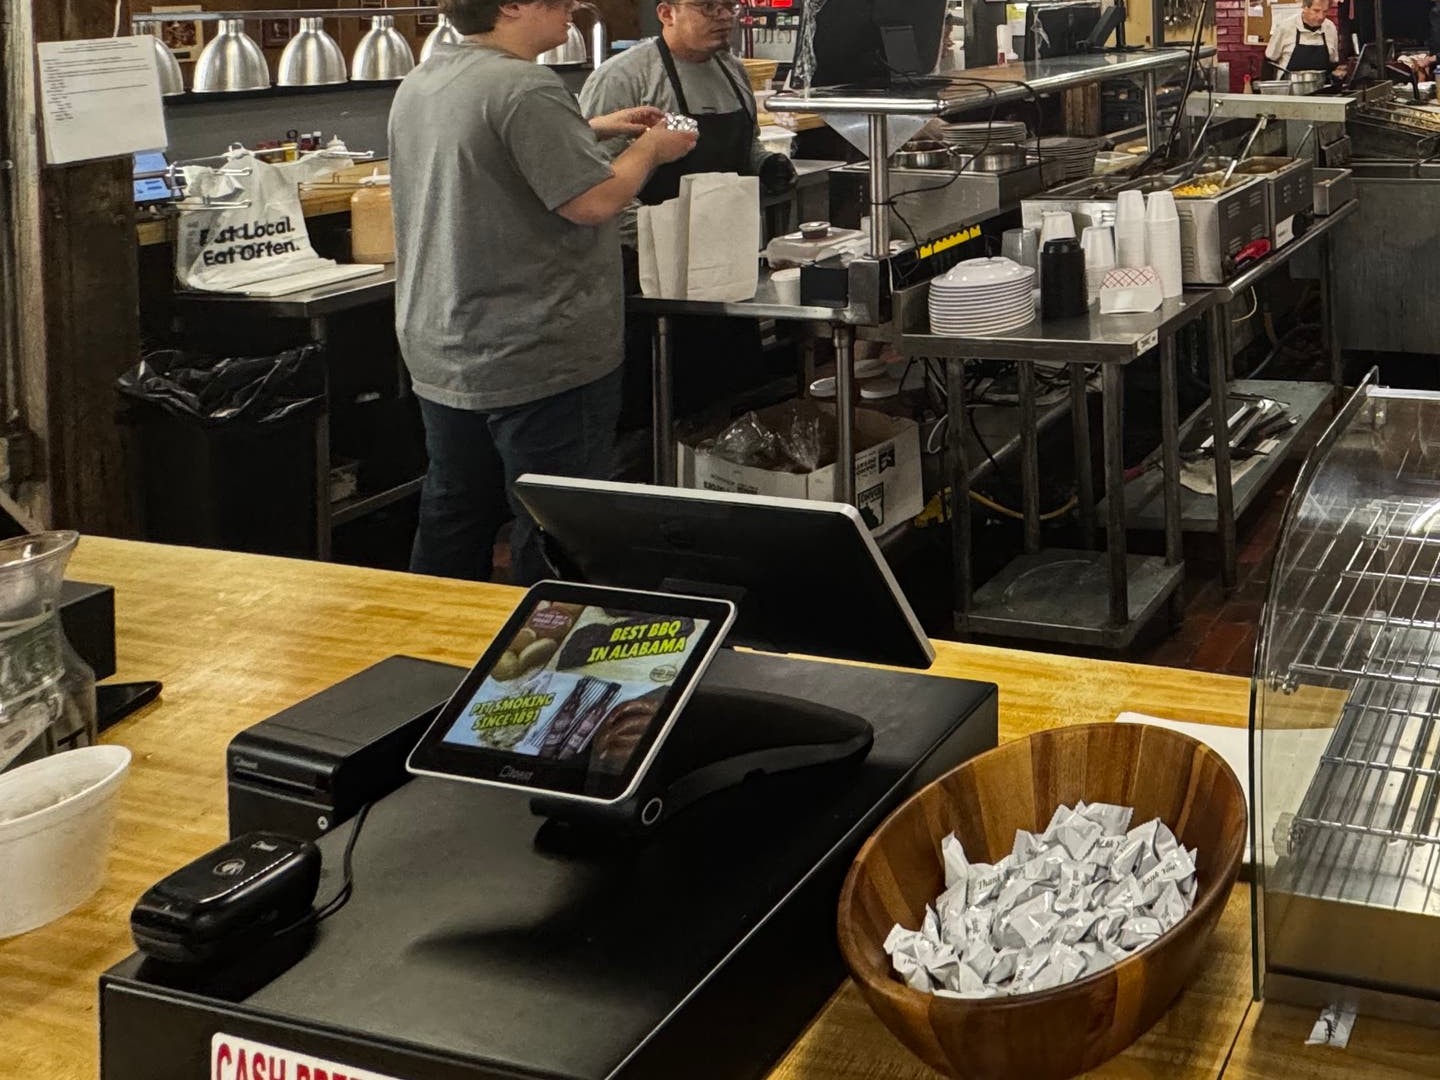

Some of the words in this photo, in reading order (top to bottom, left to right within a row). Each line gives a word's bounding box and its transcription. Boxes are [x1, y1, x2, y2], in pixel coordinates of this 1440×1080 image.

[244, 216, 295, 240] Local.
[203, 246, 236, 266] Eat
[241, 240, 300, 260] Often.
[610, 624, 648, 642] BEST
[650, 620, 681, 639] BBQ
[587, 647, 608, 663] IN
[610, 637, 687, 660] ALABAMA
[493, 692, 555, 713] SMOKING
[472, 714, 511, 730] SINCE
[513, 709, 540, 726] 1891
[216, 1042, 286, 1080] CASH
